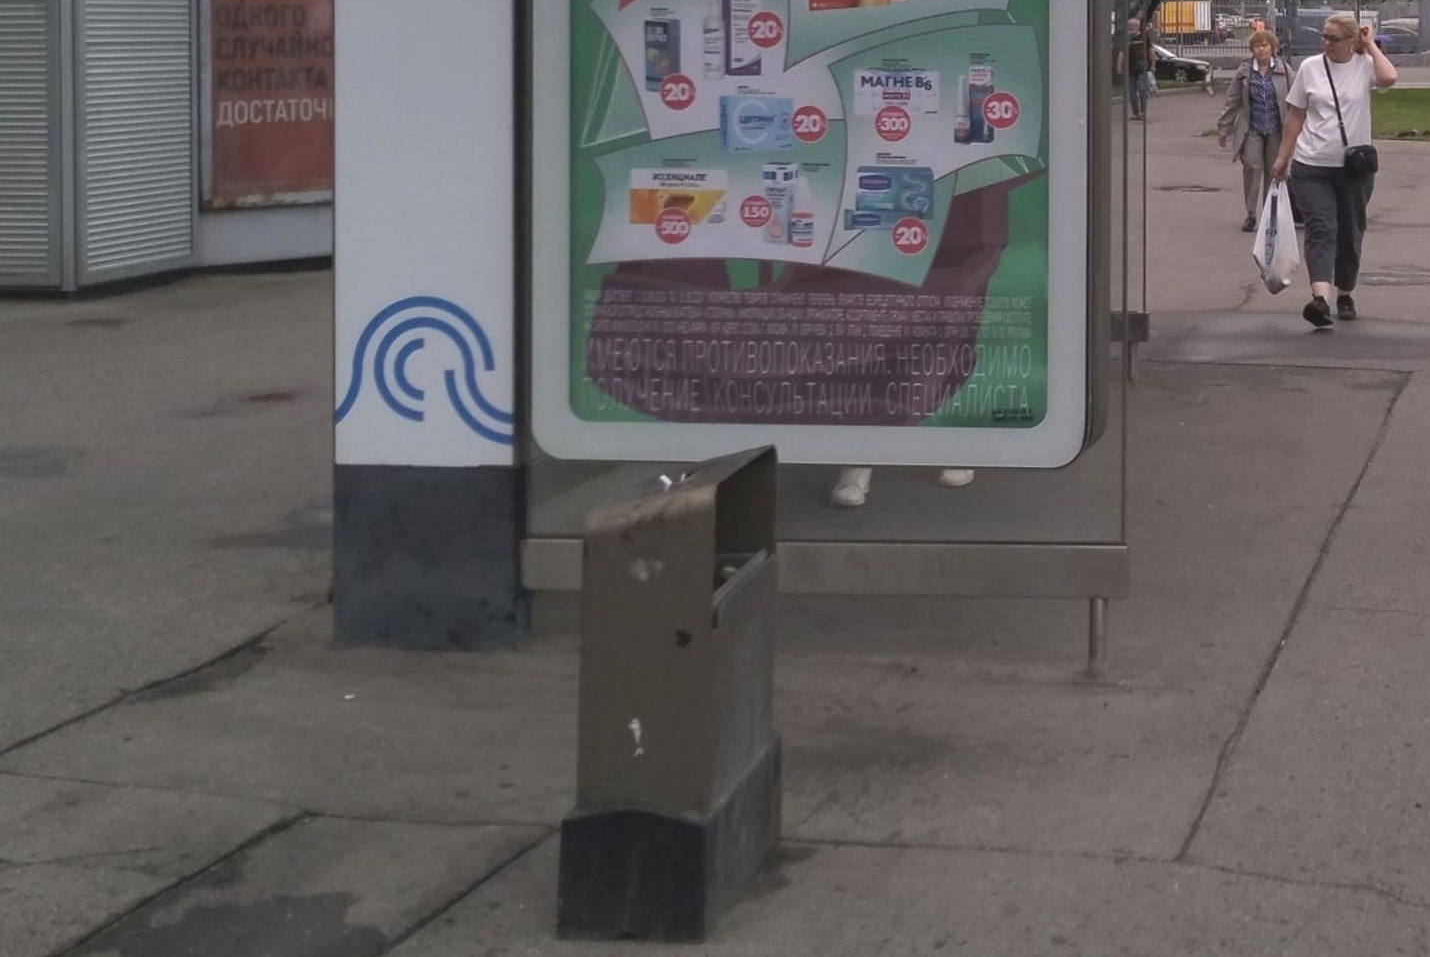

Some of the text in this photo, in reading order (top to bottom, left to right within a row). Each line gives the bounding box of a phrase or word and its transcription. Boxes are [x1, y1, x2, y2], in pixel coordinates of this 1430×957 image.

[861, 76, 913, 88] МАГНЕ
[586, 339, 678, 372] ИМЕЮТСЯ
[897, 344, 1033, 378] НЕОБХОДИМО
[582, 377, 701, 413] ПОЛУЧЕНИЕ
[713, 380, 872, 417] КОНСУЛЬТАЦИИ
